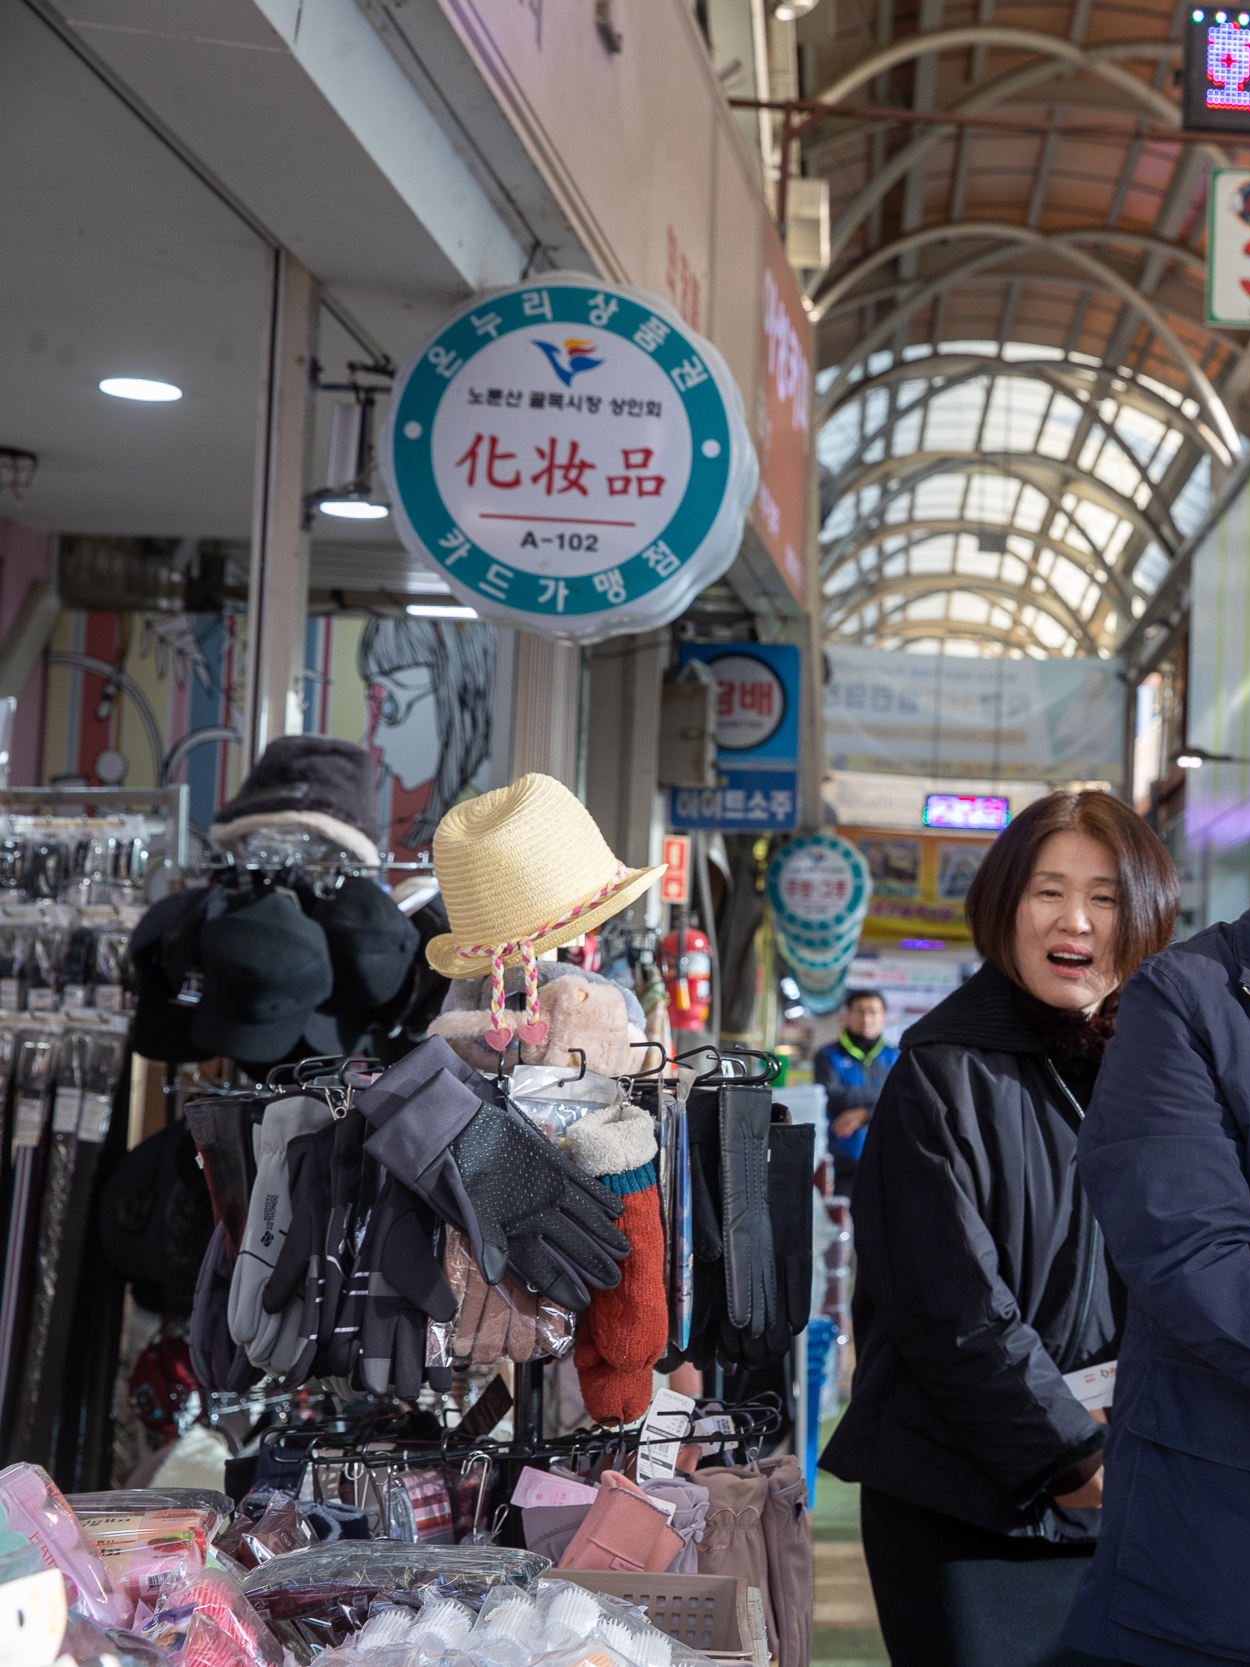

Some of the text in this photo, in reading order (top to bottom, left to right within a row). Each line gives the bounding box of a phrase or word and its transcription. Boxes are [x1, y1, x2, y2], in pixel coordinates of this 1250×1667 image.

[468, 387, 663, 419] 노룬산 골목시장 상인회
[455, 432, 666, 498] 化妆品
[520, 530, 598, 552] A-102
[438, 527, 681, 613] 카드가맹점
